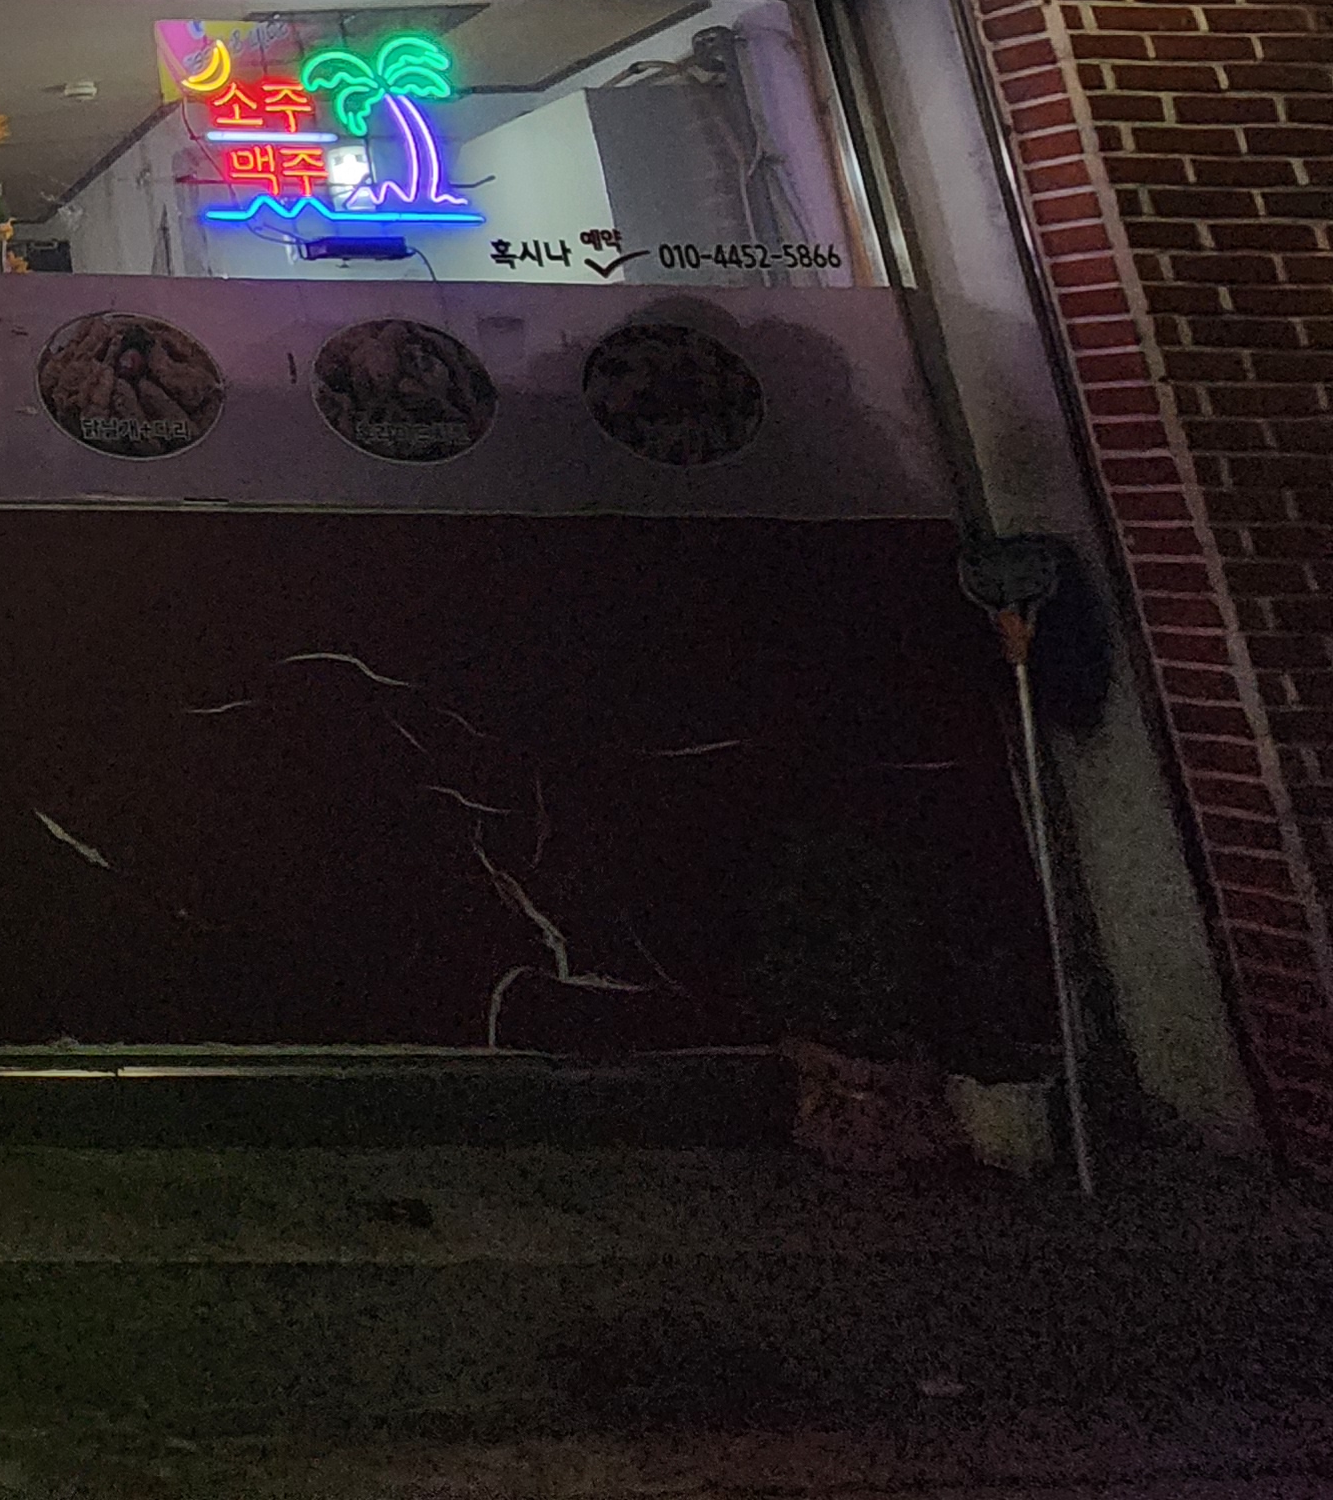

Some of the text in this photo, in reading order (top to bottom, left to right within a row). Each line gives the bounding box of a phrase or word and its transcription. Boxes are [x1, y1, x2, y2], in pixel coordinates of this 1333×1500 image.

[213, 82, 312, 132] 소주
[229, 145, 325, 196] 맥주
[489, 229, 841, 269] 혹시나 예약 010-4452-5866
